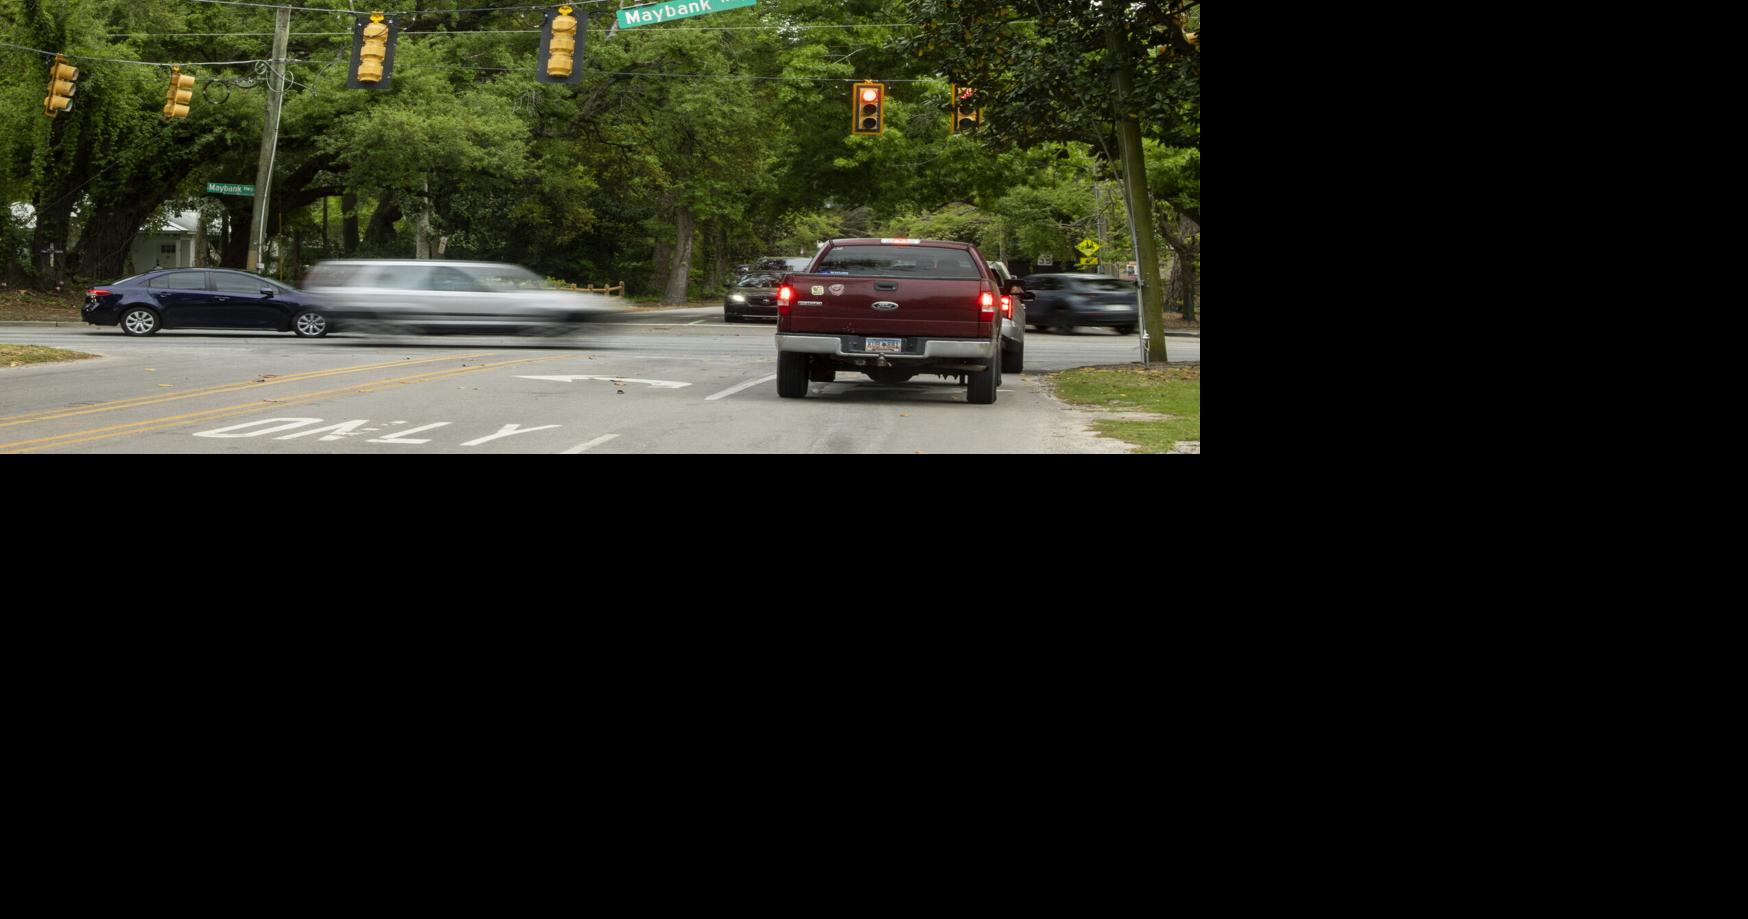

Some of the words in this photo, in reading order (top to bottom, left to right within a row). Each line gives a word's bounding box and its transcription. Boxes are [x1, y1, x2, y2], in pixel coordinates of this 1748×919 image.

[624, 0, 711, 25] Maybank
[209, 183, 242, 193] Maybank
[192, 417, 563, 447] ONLY
